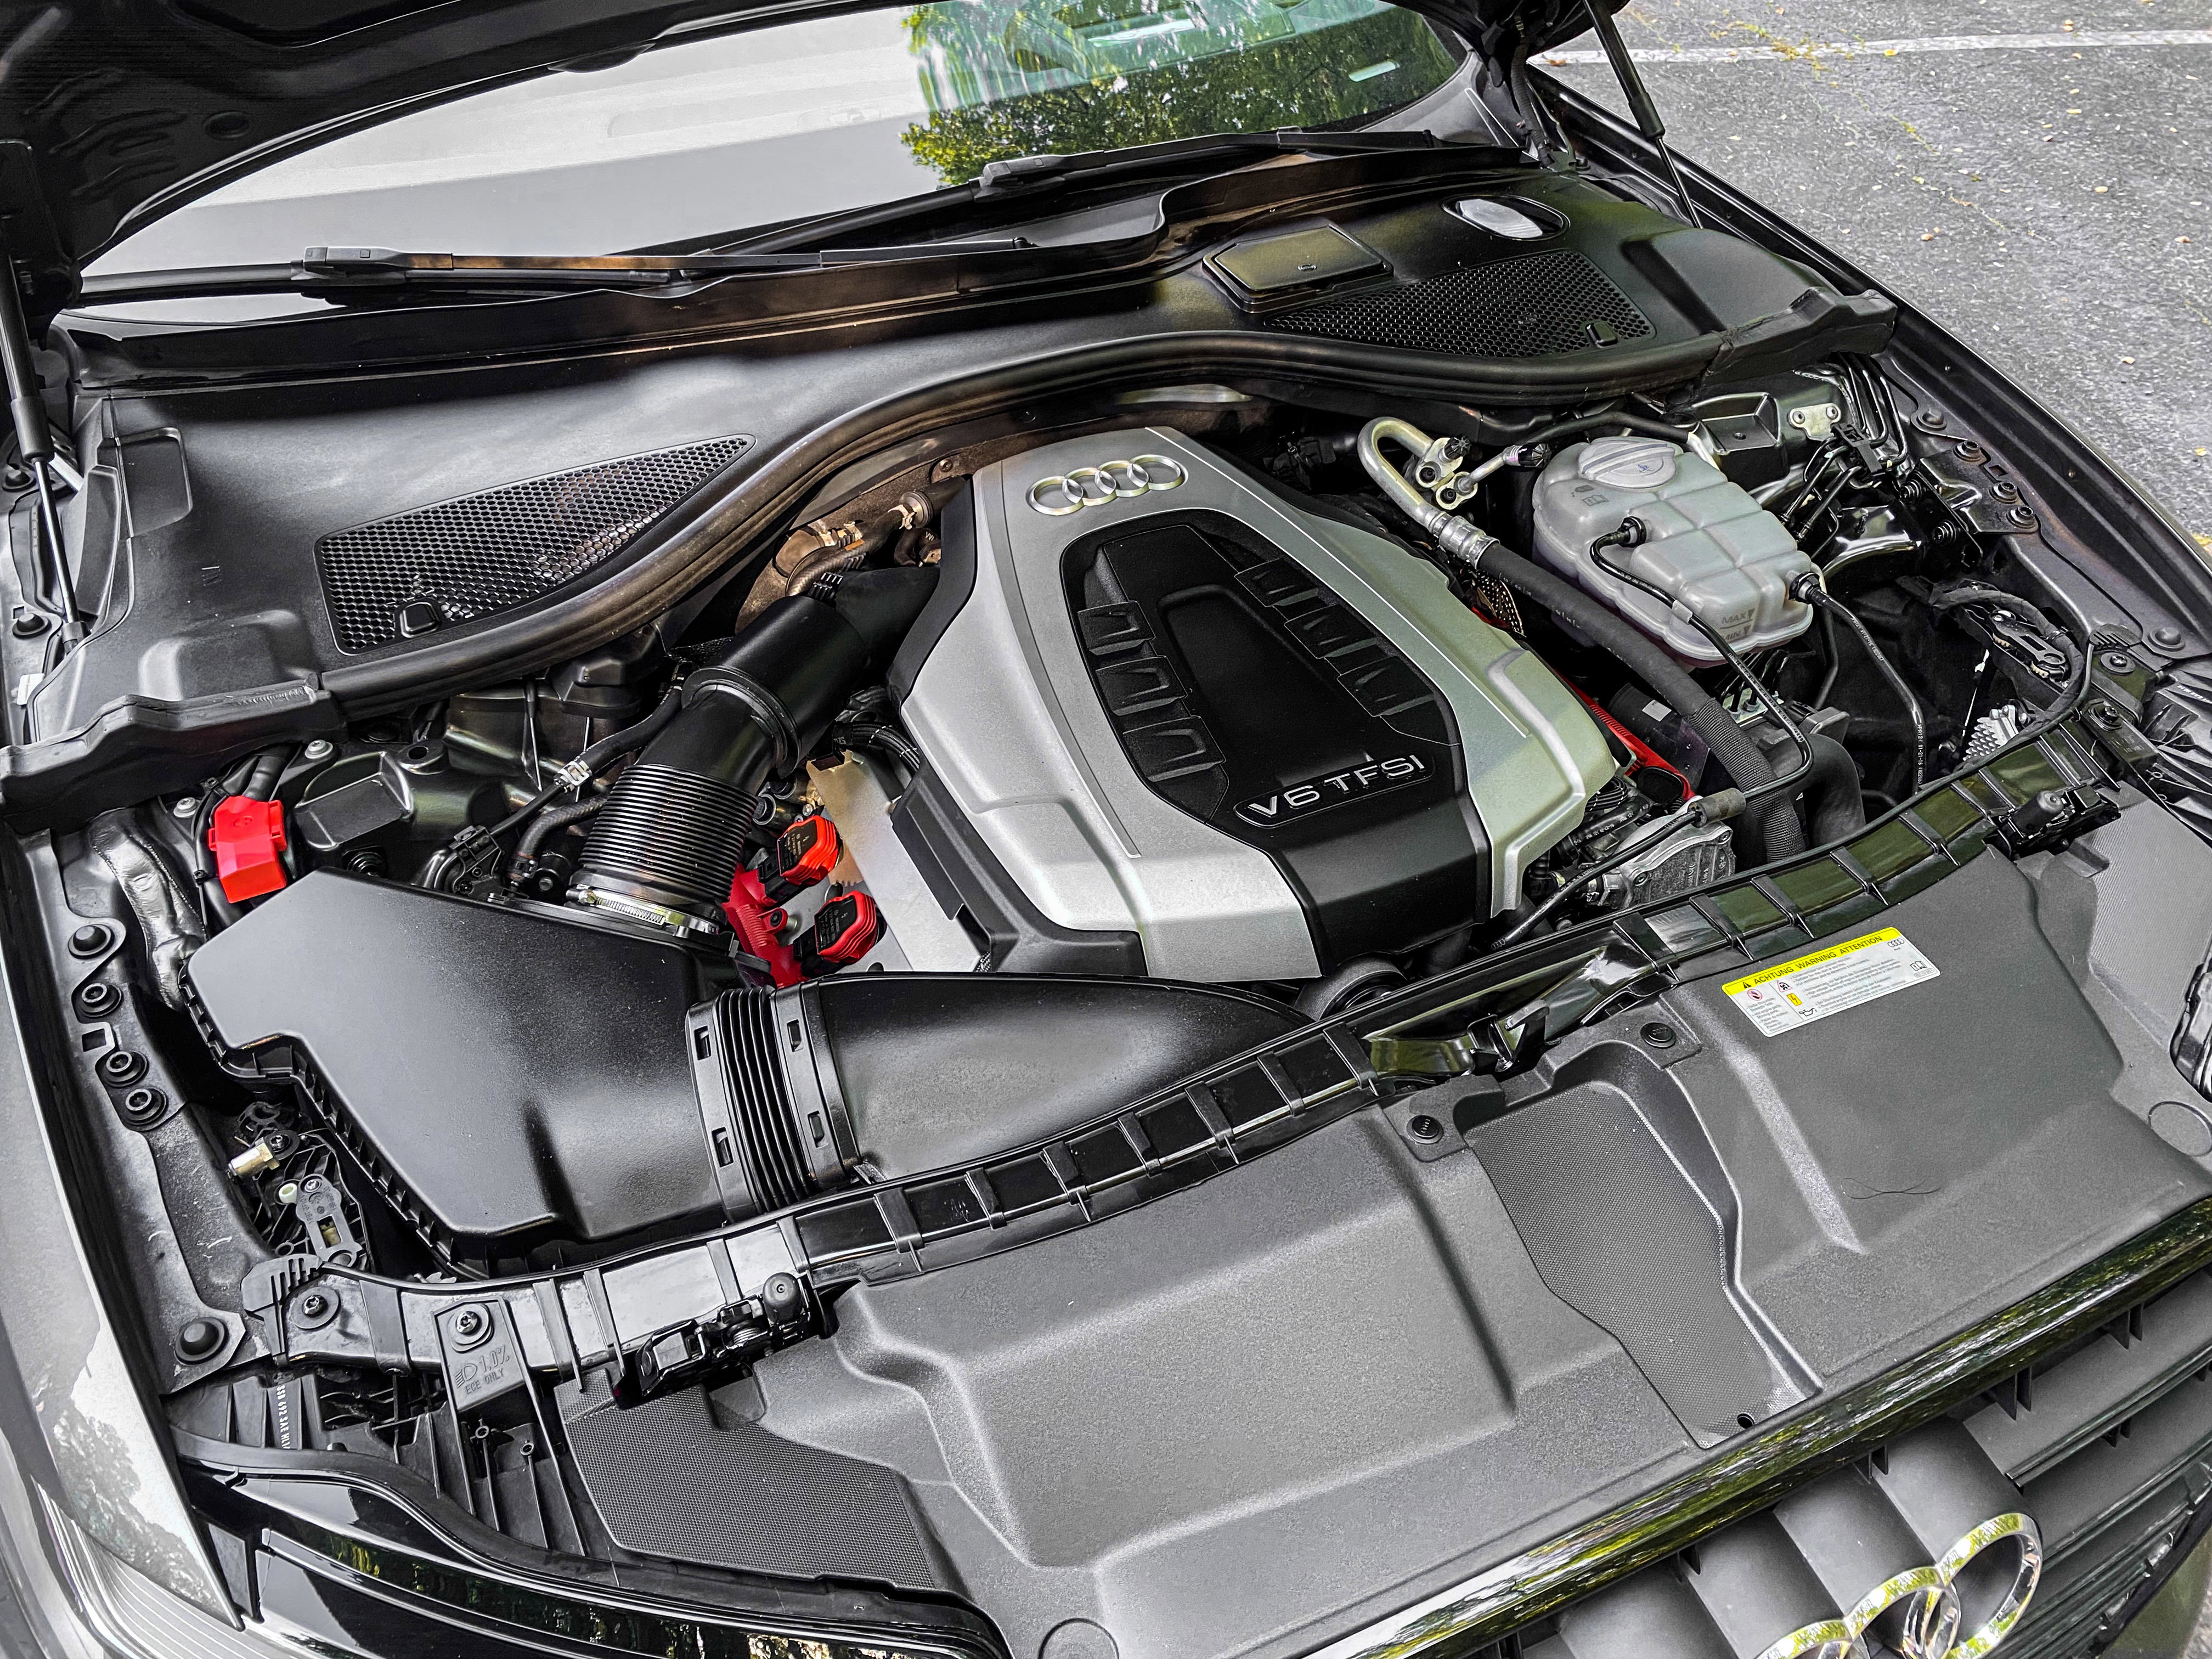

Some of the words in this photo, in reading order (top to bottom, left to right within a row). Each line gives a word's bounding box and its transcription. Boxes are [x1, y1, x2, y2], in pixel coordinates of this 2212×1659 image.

[1722, 613, 1746, 624] MAX
[1248, 785, 1320, 818] V6
[1323, 754, 1426, 794] TFSI
[1754, 967, 1794, 985] ACHTUNG
[1795, 952, 1837, 969] WARNING
[1839, 936, 1883, 955] ATTENTION
[465, 1380, 481, 1395] ECE
[484, 1368, 504, 1385] ONLY
[276, 1385, 286, 1400] SSB
[278, 1401, 287, 1416] 692
[279, 1417, 289, 1433] SAE
